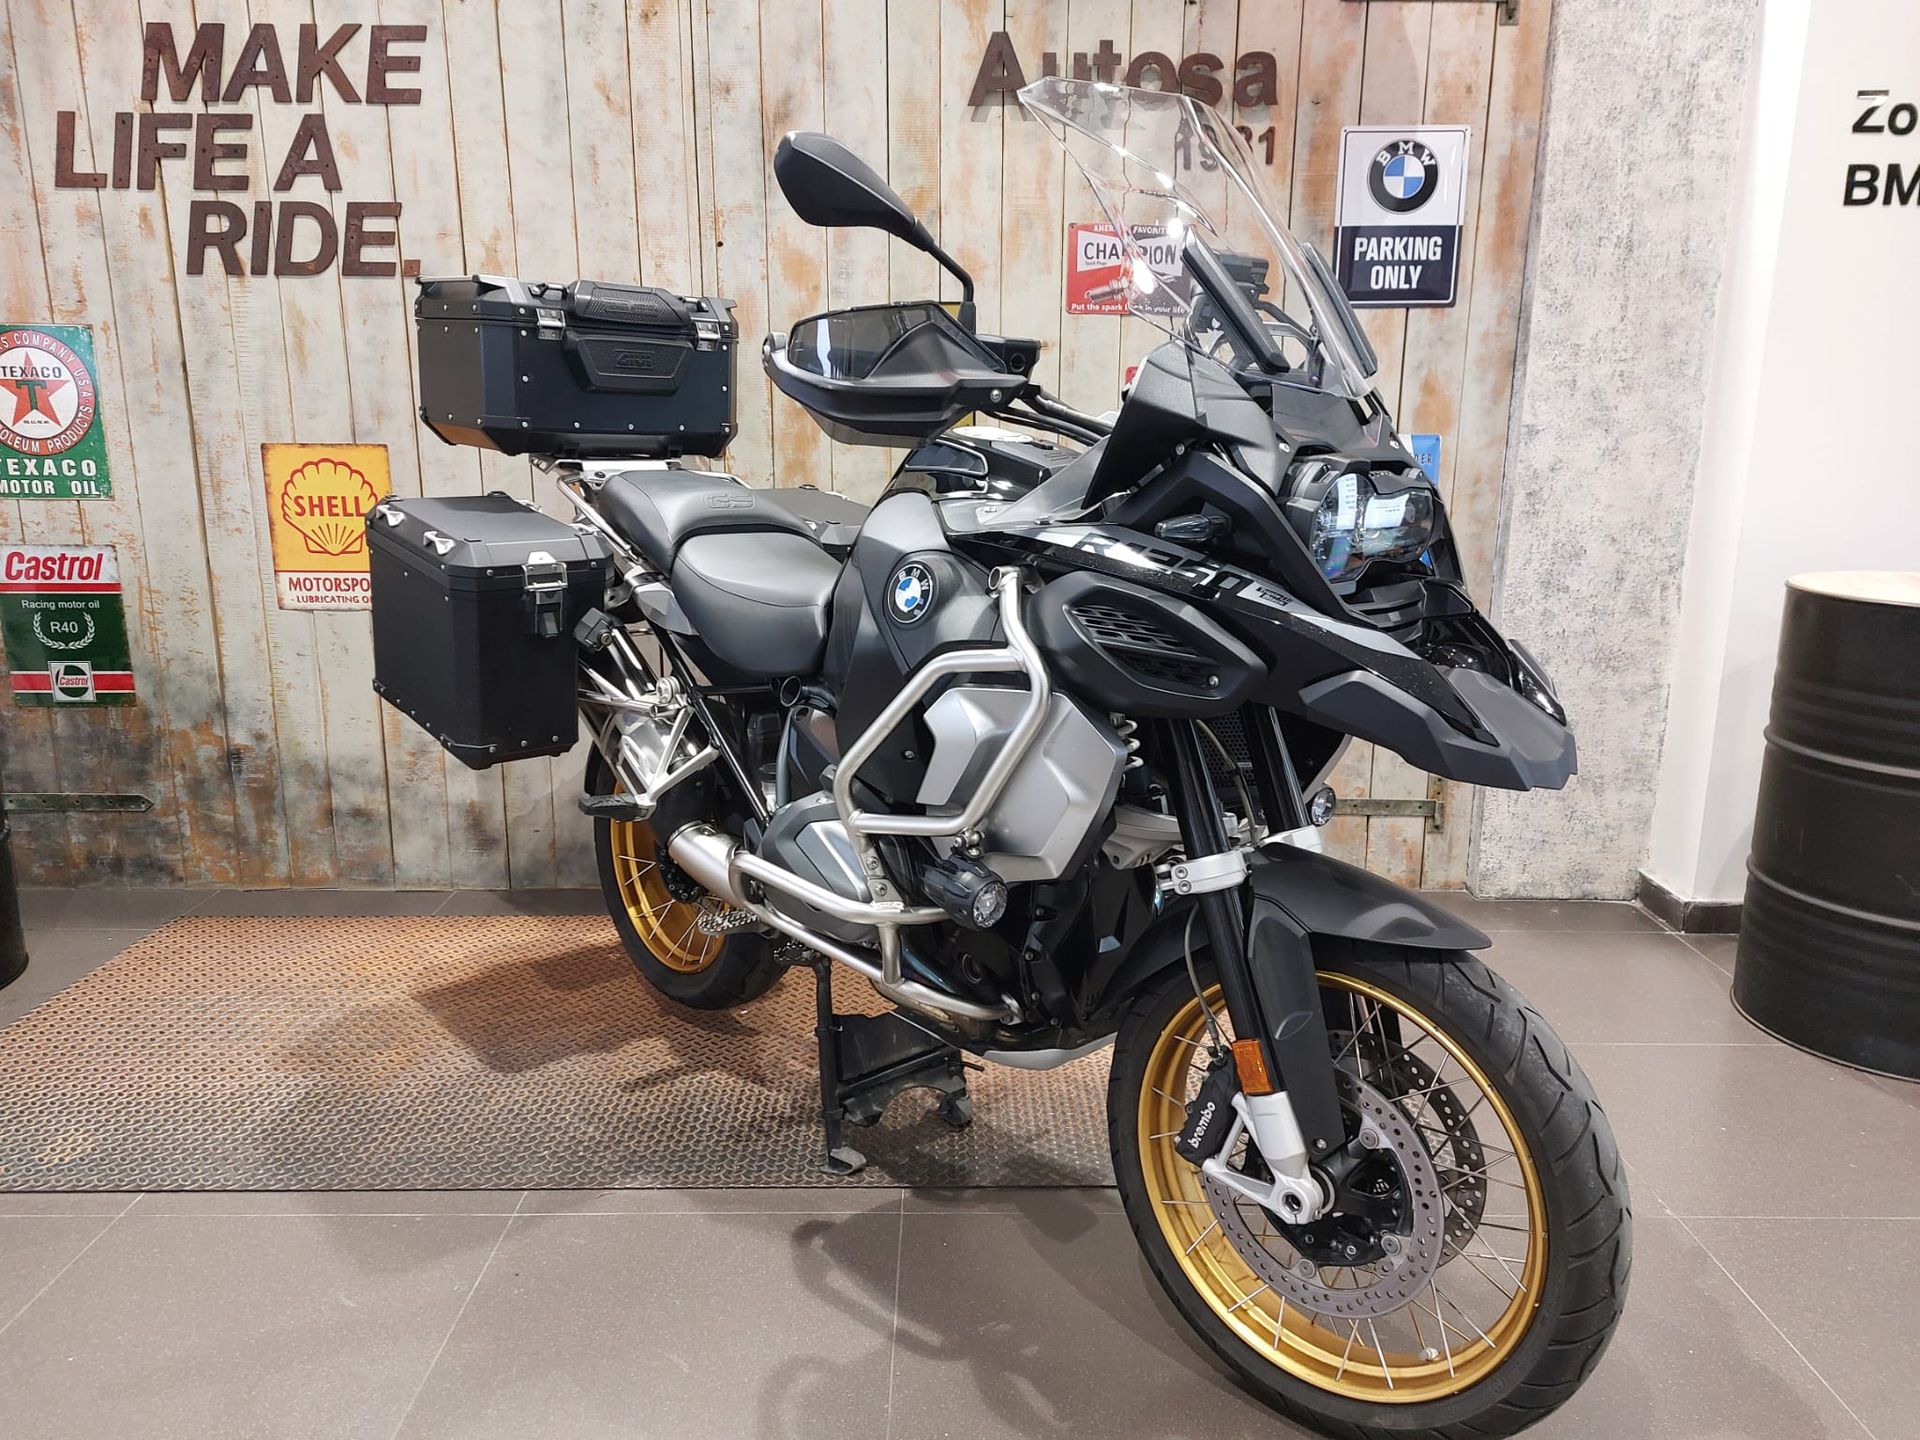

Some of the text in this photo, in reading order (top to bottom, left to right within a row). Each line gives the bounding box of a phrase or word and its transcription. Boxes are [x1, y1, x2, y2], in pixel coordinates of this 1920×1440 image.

[141, 22, 427, 104] MAKE
[968, 31, 1279, 108] Autosa
[1851, 89, 1919, 136] Zo
[55, 111, 342, 191] LIFE A
[1376, 141, 1436, 167] BMW
[186, 200, 420, 277] RIDE.
[1354, 236, 1443, 261] PARKING
[1370, 265, 1423, 290] ONLY
[1071, 303, 1086, 311] Put
[1087, 303, 1100, 311] the
[1101, 303, 1123, 312] spark
[13, 332, 76, 366] COMPANY
[1, 366, 62, 378] TEXACO
[0, 405, 93, 453] OLEUM PRODUCTS
[0, 457, 97, 477] EXACO
[0, 479, 100, 495] MOTOR OIL
[293, 495, 366, 517] SHELL
[5, 551, 104, 581] Castrol
[288, 577, 371, 593] MOTORSPO
[898, 567, 930, 591] BMW
[21, 599, 100, 611] Racing motor oil
[296, 595, 360, 604] LUBRICATING
[50, 621, 78, 634] R40
[59, 676, 89, 686] Castrol
[1187, 1101, 1216, 1149] brembo
